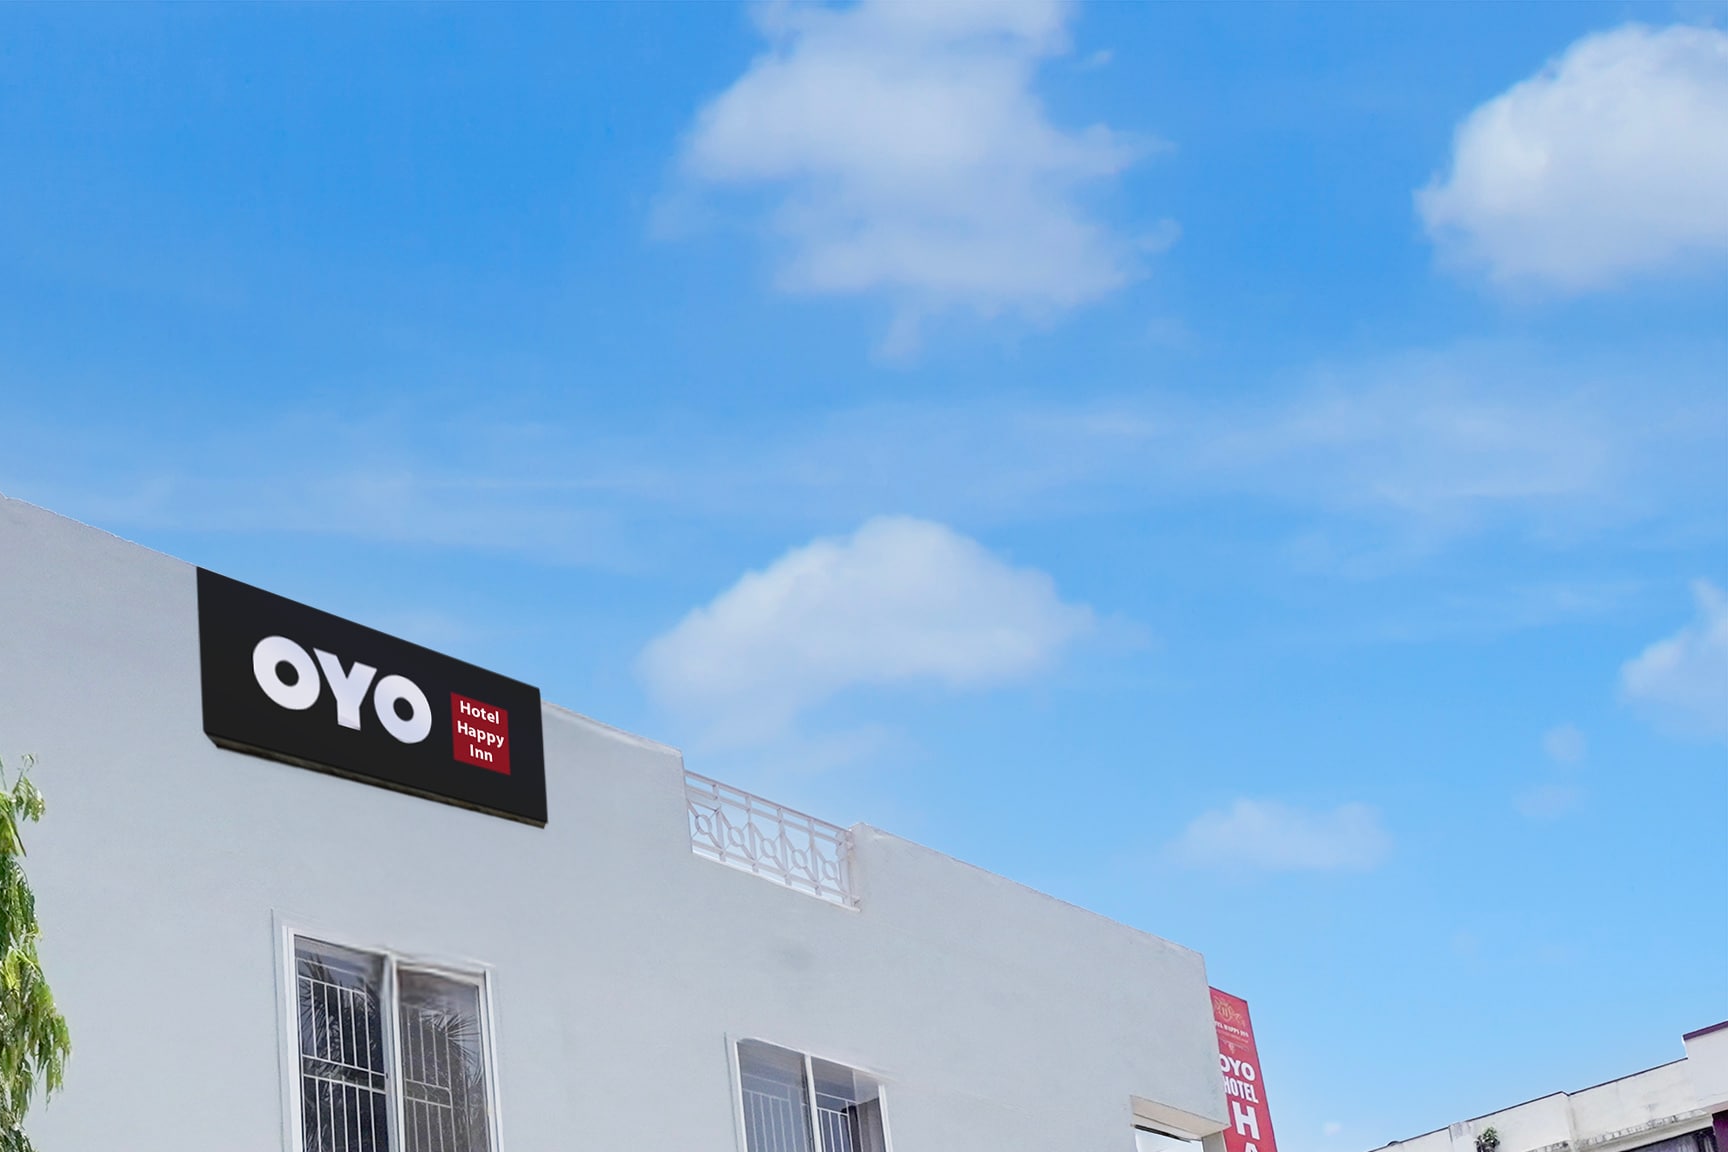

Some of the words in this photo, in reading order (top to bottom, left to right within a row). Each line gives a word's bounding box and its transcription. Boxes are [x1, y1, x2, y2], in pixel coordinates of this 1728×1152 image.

[253, 635, 432, 744] OYO
[459, 699, 499, 725] Hotel
[457, 720, 505, 748] Happy
[469, 743, 493, 762] Inn
[1219, 1053, 1256, 1082] OYO
[1223, 1075, 1260, 1104] HOTEL
